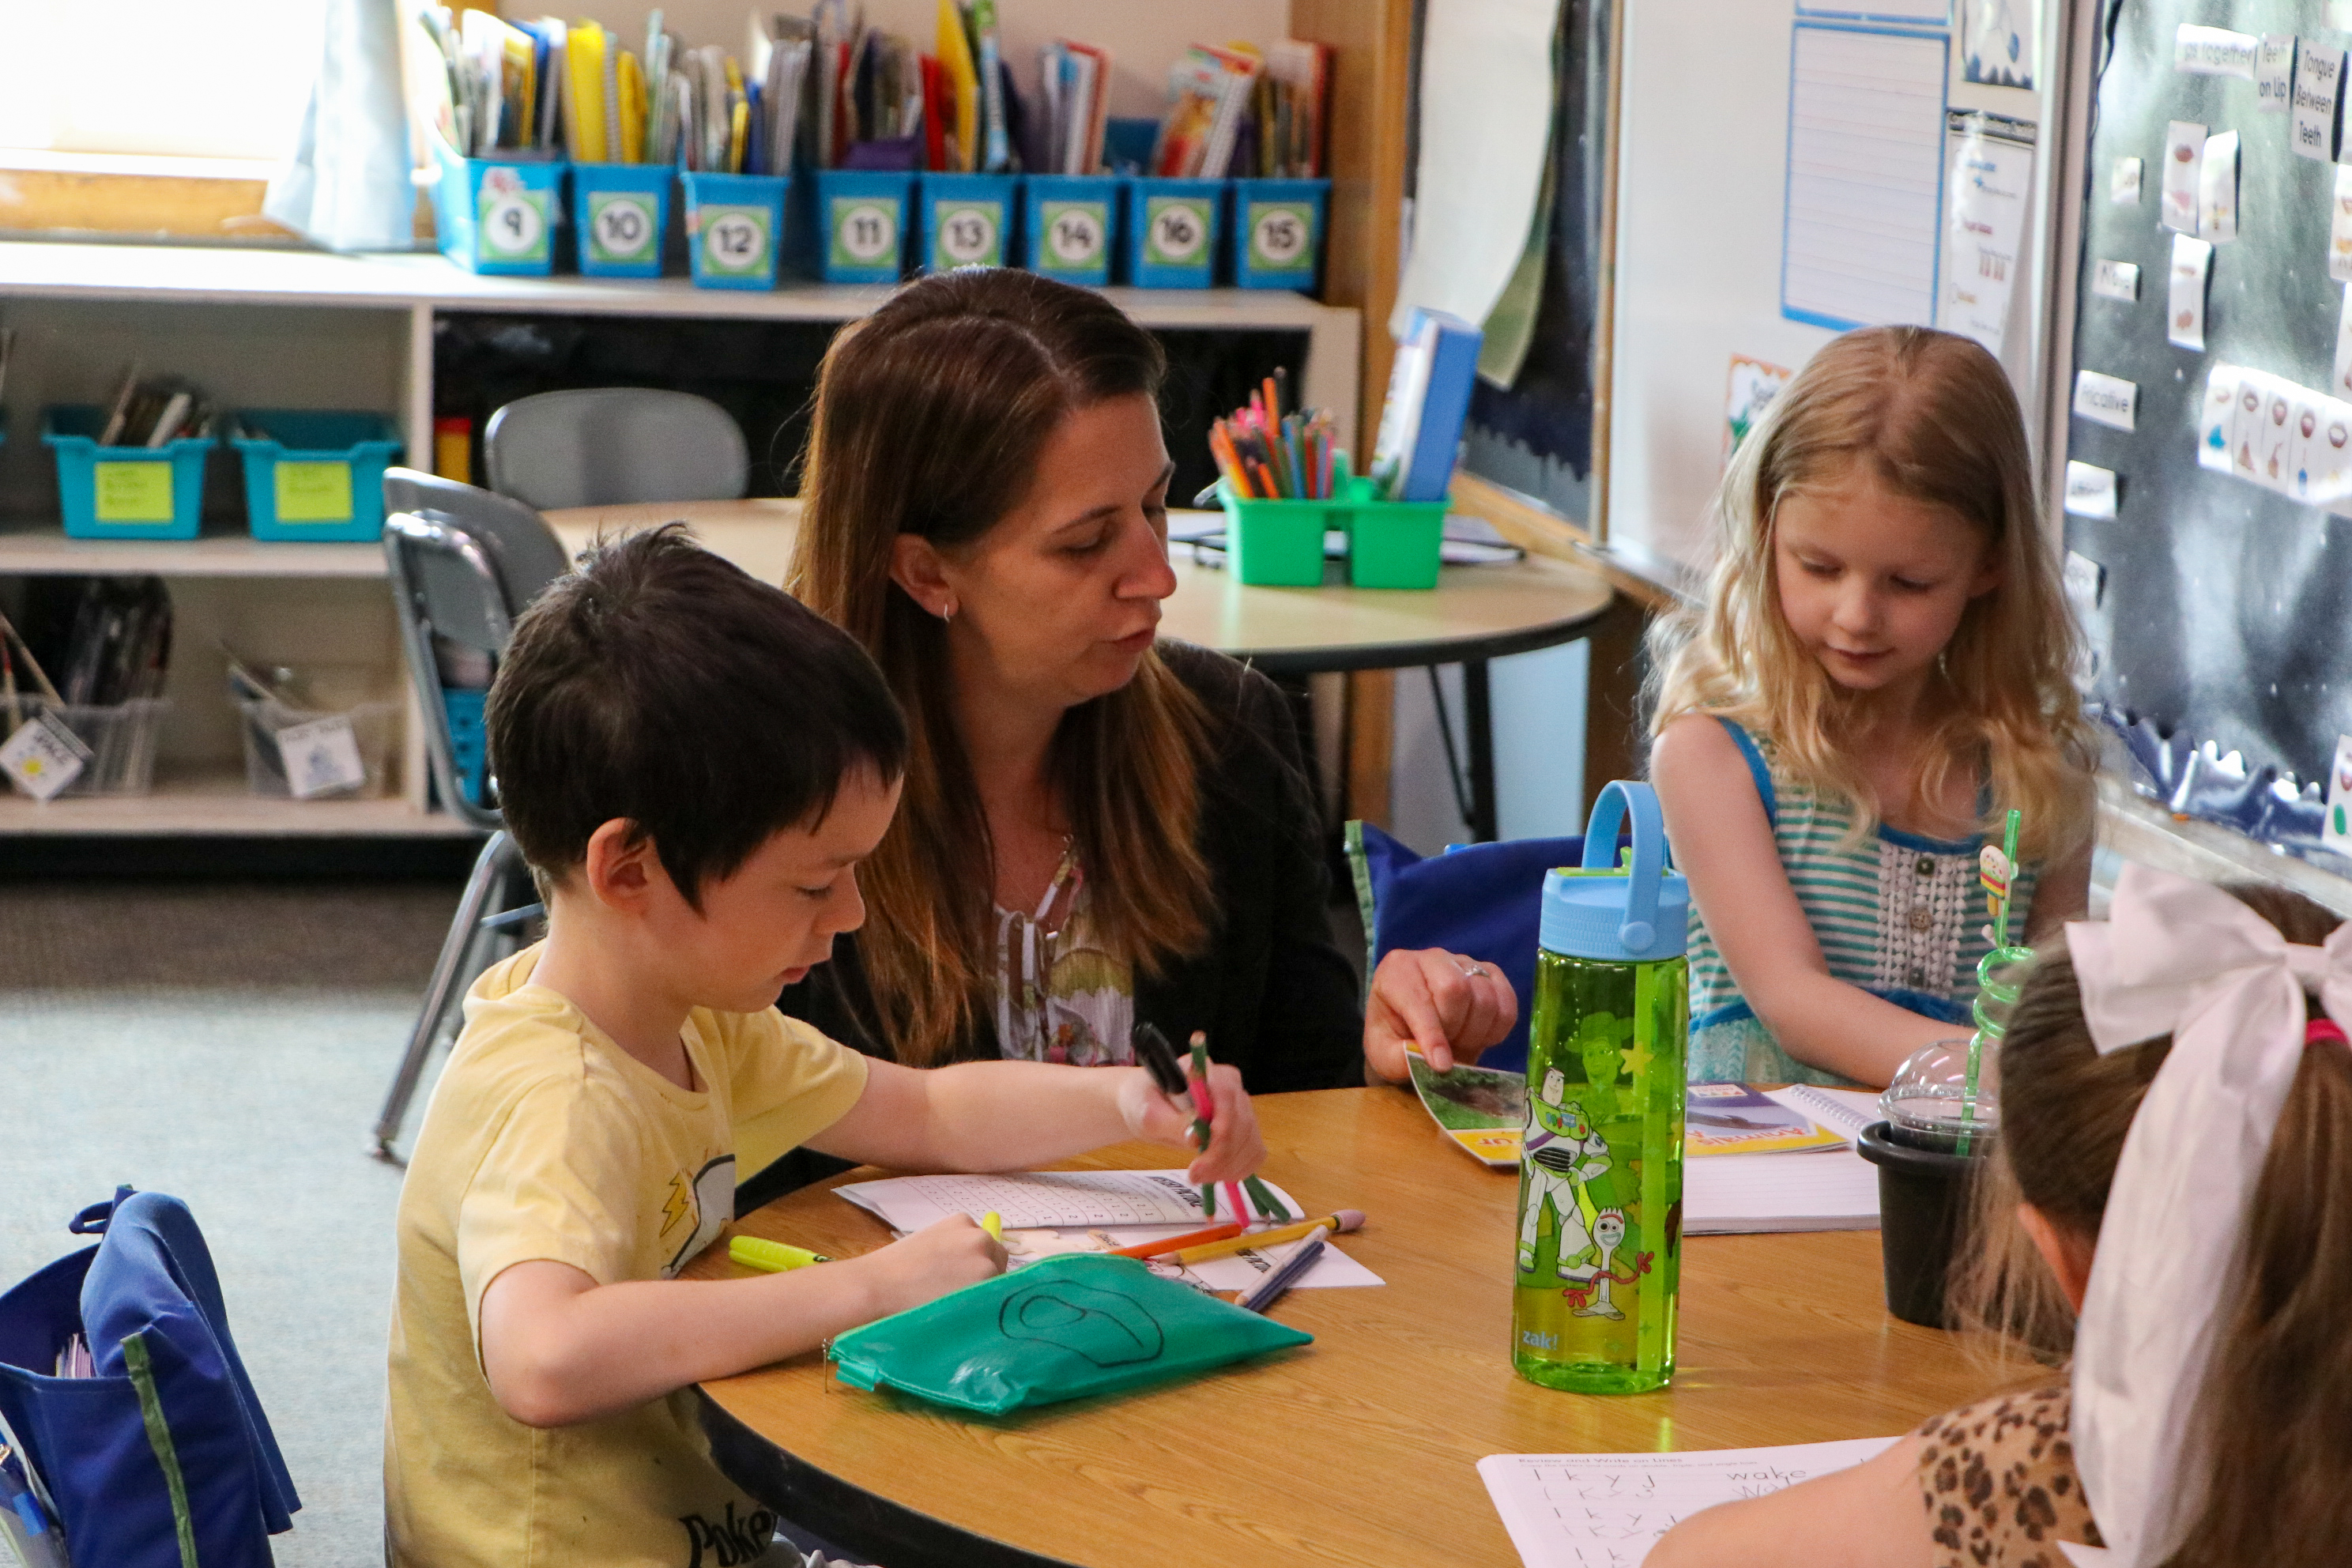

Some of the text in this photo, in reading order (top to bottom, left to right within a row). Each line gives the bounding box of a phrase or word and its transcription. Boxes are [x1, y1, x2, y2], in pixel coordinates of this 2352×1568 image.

[2263, 41, 2287, 63] Teeth
[2303, 49, 2335, 81] Tongue
[2259, 76, 2287, 103] on Lip
[2295, 84, 2332, 115] Between
[2299, 120, 2322, 147] Teeth
[504, 209, 522, 237] 9
[604, 211, 641, 239] 10
[854, 218, 881, 246] 11
[949, 219, 983, 247] 13
[1058, 222, 1090, 248] 14
[1161, 217, 1192, 243] 16
[1265, 222, 1294, 248] 15
[718, 224, 752, 253] 12
[1694, 1127, 1806, 1146] Animals
[1522, 1329, 1558, 1351] zak!
[1564, 1468, 1581, 1481] k
[1604, 1474, 1620, 1488] y
[1642, 1472, 1656, 1488] j
[1726, 1465, 1807, 1480] wake
[1585, 1507, 1603, 1519] k
[1626, 1513, 1642, 1527] y
[1607, 1547, 1626, 1561] k
